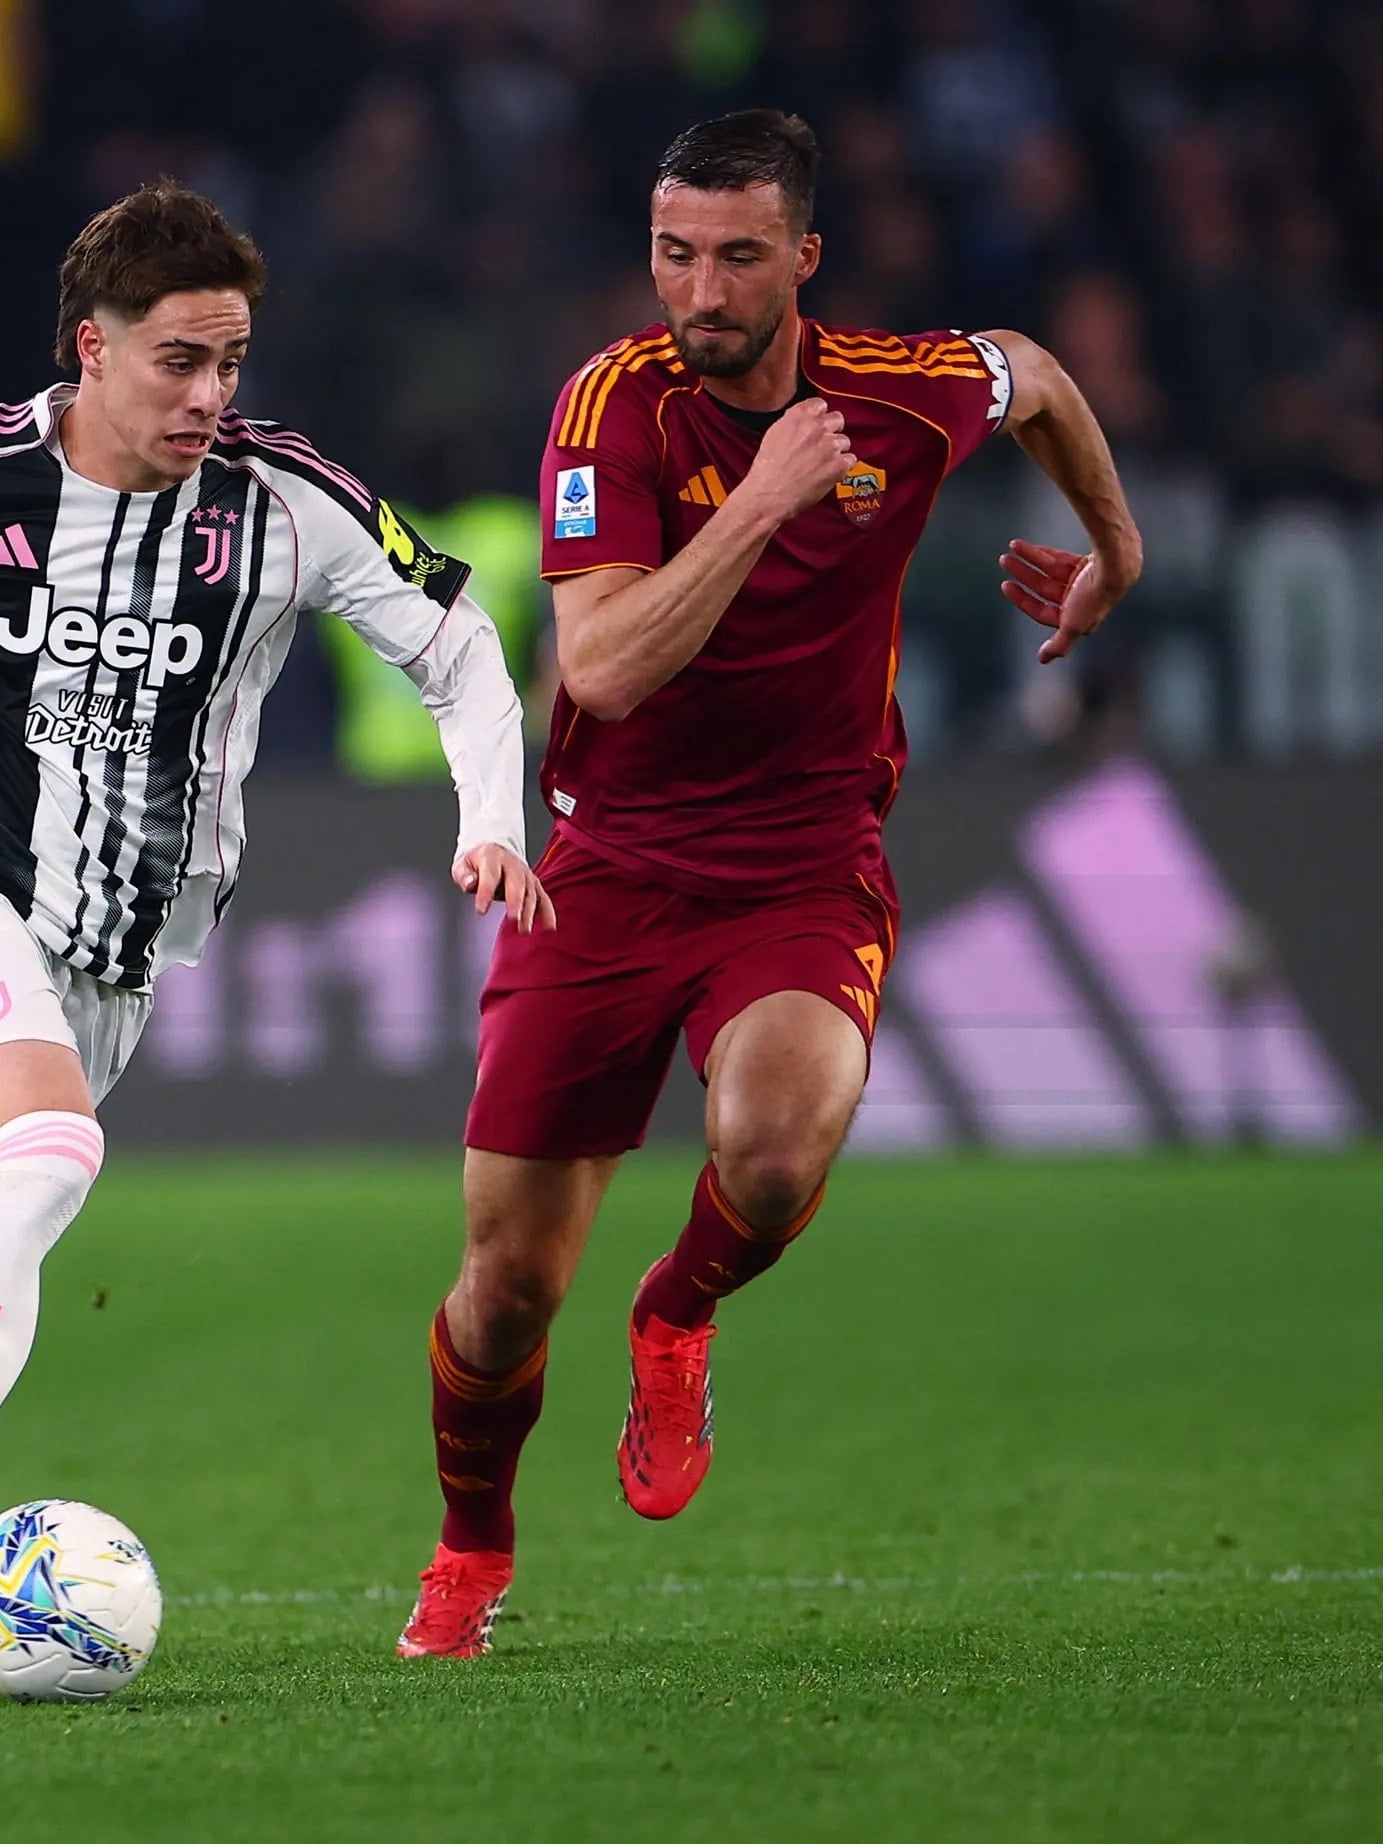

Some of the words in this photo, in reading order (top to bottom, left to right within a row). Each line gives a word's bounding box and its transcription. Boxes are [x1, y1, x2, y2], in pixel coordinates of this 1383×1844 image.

[561, 505, 582, 514] SERIE
[844, 498, 880, 513] ROMA
[59, 689, 128, 720] VISIT
[27, 704, 152, 754] Detroit
